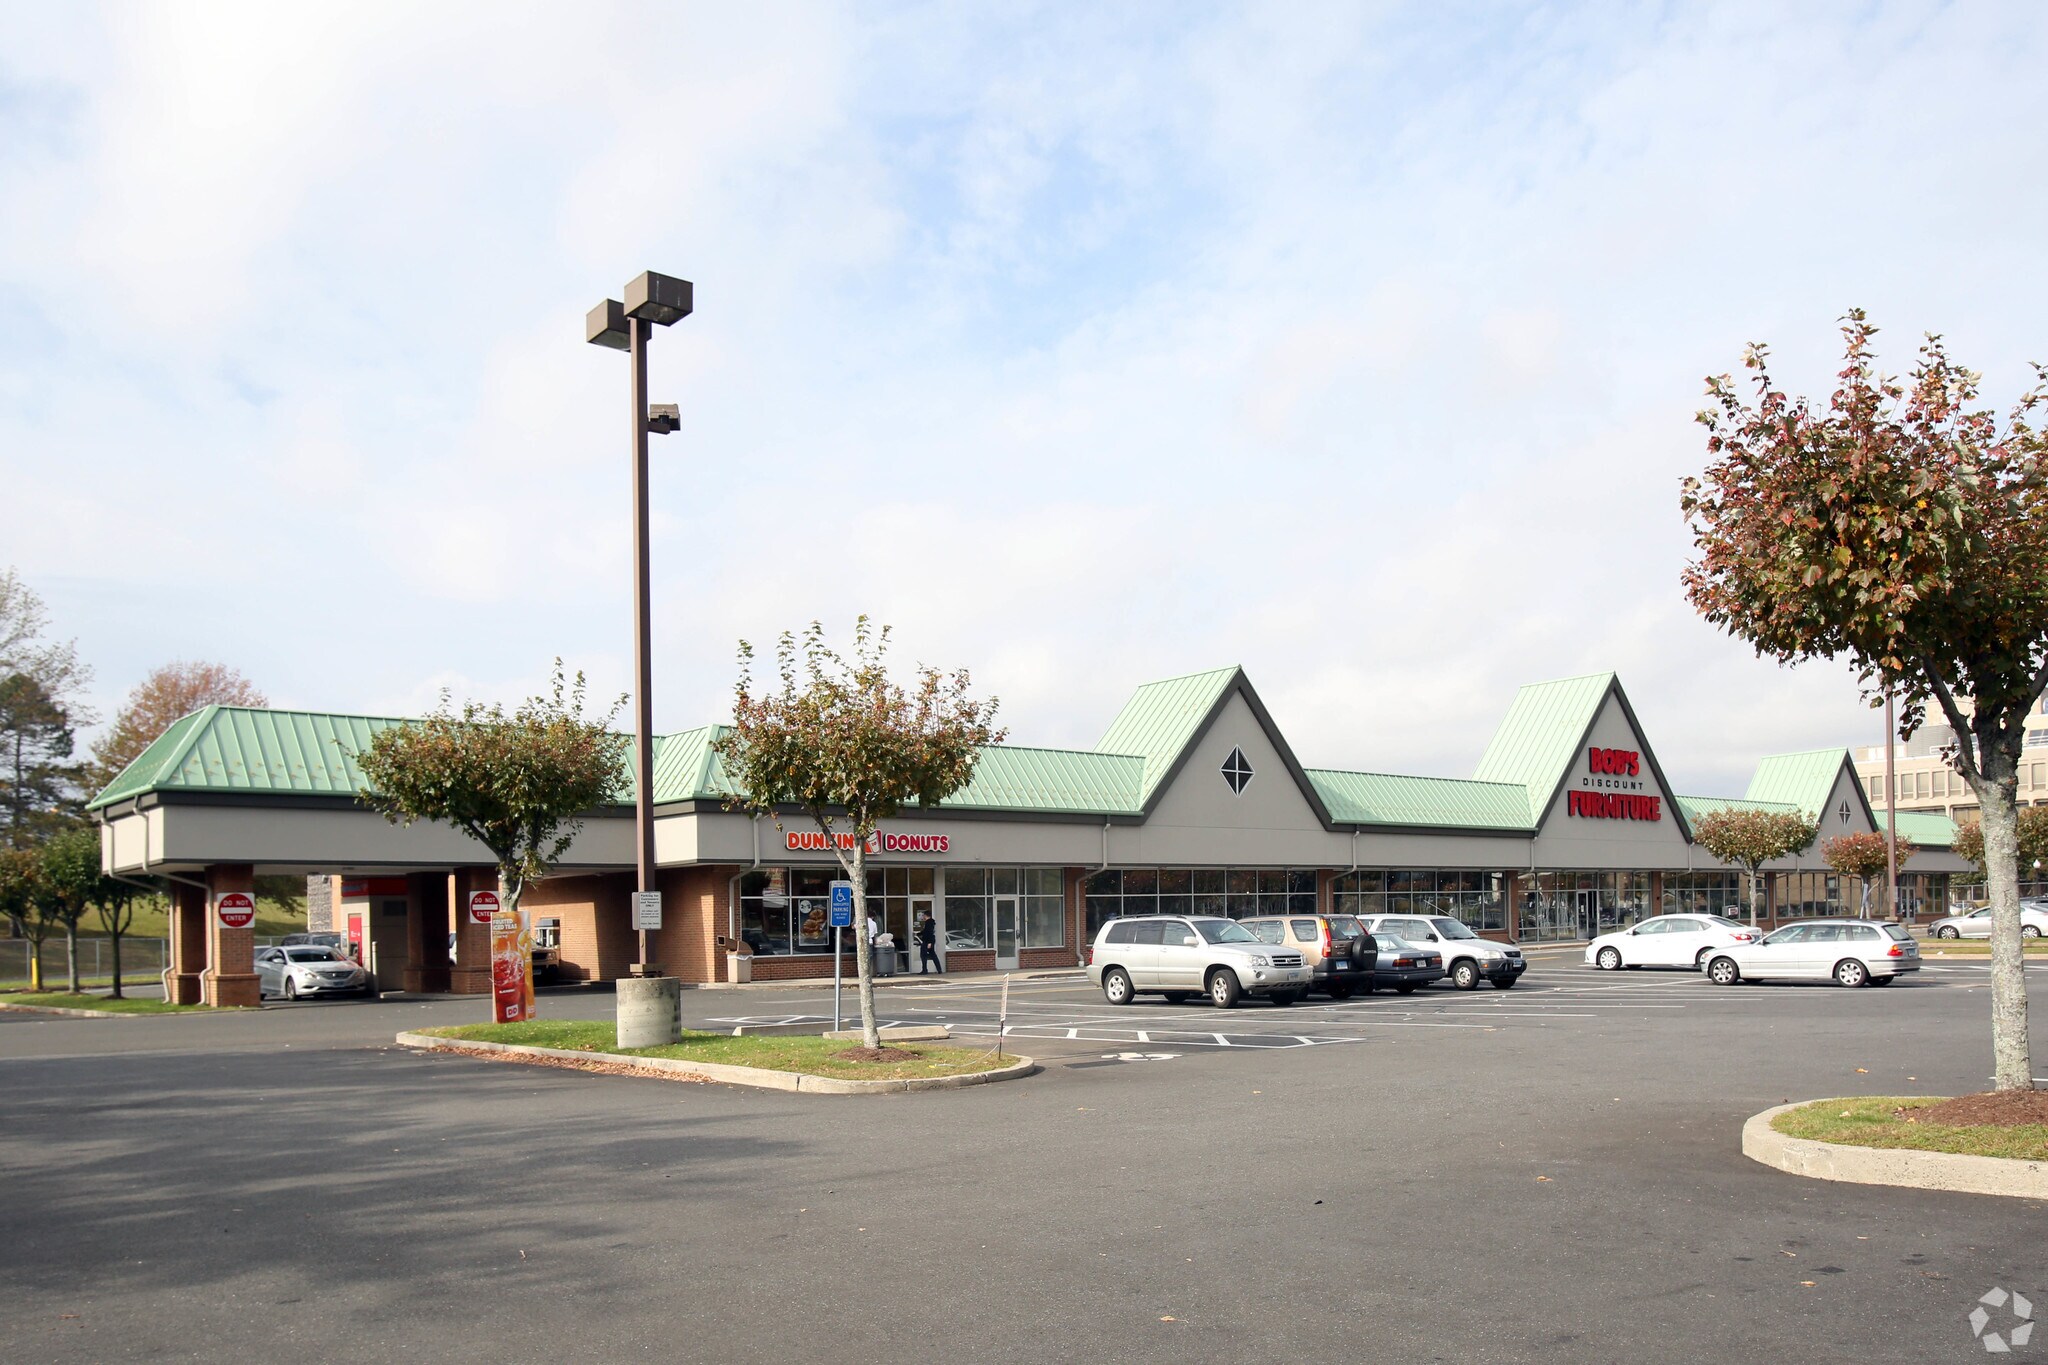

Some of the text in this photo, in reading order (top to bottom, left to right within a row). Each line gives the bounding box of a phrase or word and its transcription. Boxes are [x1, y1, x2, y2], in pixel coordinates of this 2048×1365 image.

[1589, 747, 1640, 777] BOB'S
[1583, 778, 1643, 790] DISCOUNT
[1568, 790, 1661, 821] FURNITURE
[885, 833, 950, 853] DONUTS
